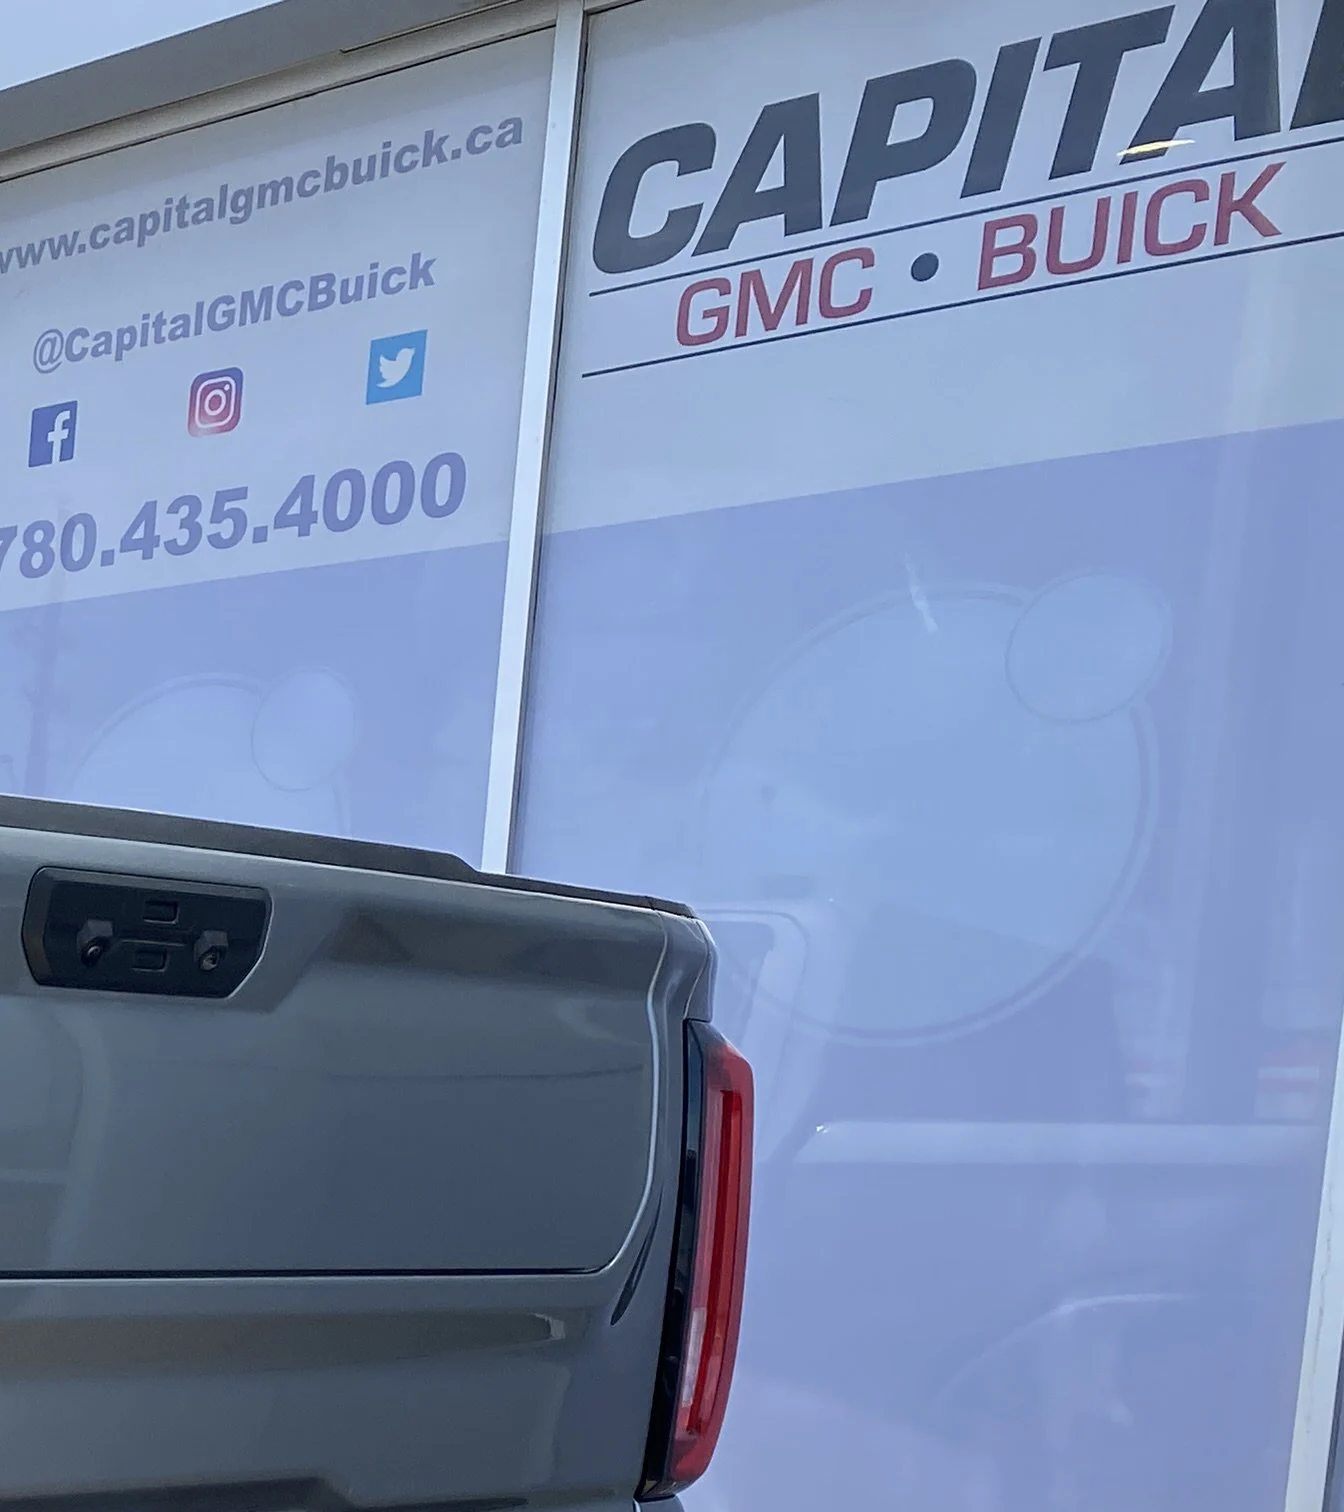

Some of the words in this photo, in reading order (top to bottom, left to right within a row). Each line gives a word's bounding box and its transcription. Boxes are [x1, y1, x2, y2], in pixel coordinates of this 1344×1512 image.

[32, 252, 437, 374] @CapitalGMCBuick
[676, 247, 875, 346] GMC
[976, 161, 1287, 290] BUICK
